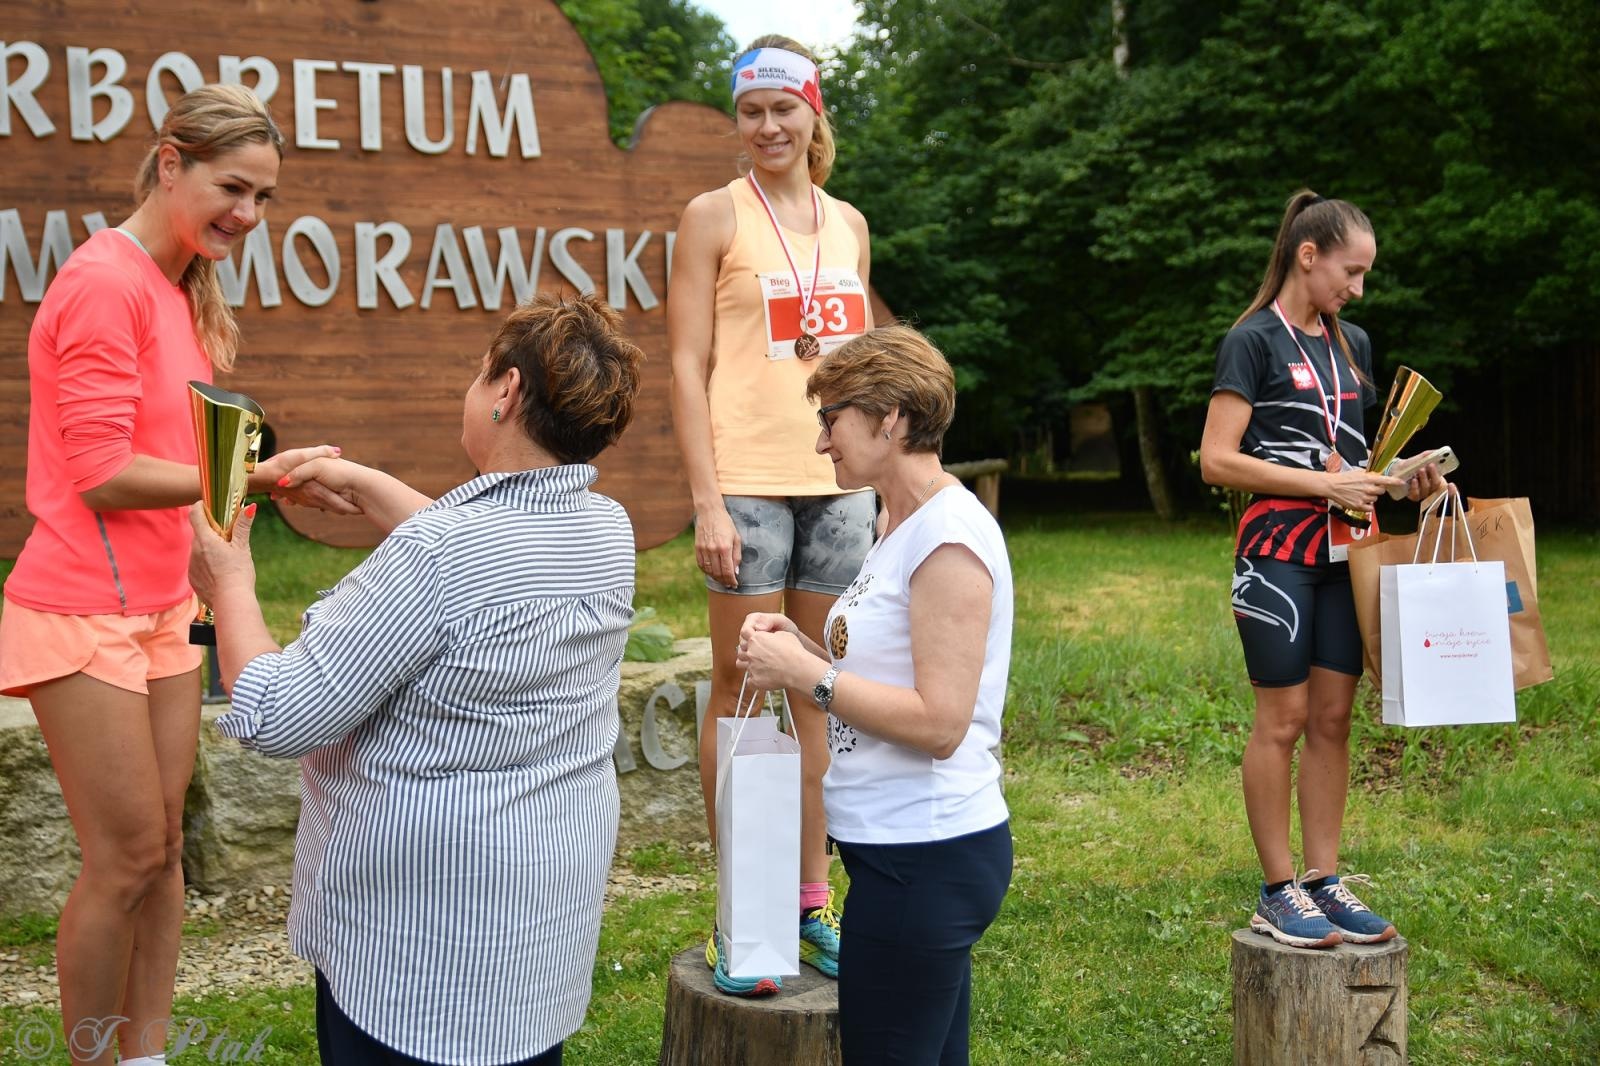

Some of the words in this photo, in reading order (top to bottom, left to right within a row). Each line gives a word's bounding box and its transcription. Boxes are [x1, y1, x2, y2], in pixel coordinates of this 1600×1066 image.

[757, 71, 801, 85] MARATHON
[758, 66, 786, 74] SILESIA
[799, 297, 848, 335] 83
[1495, 514, 1504, 532] K
